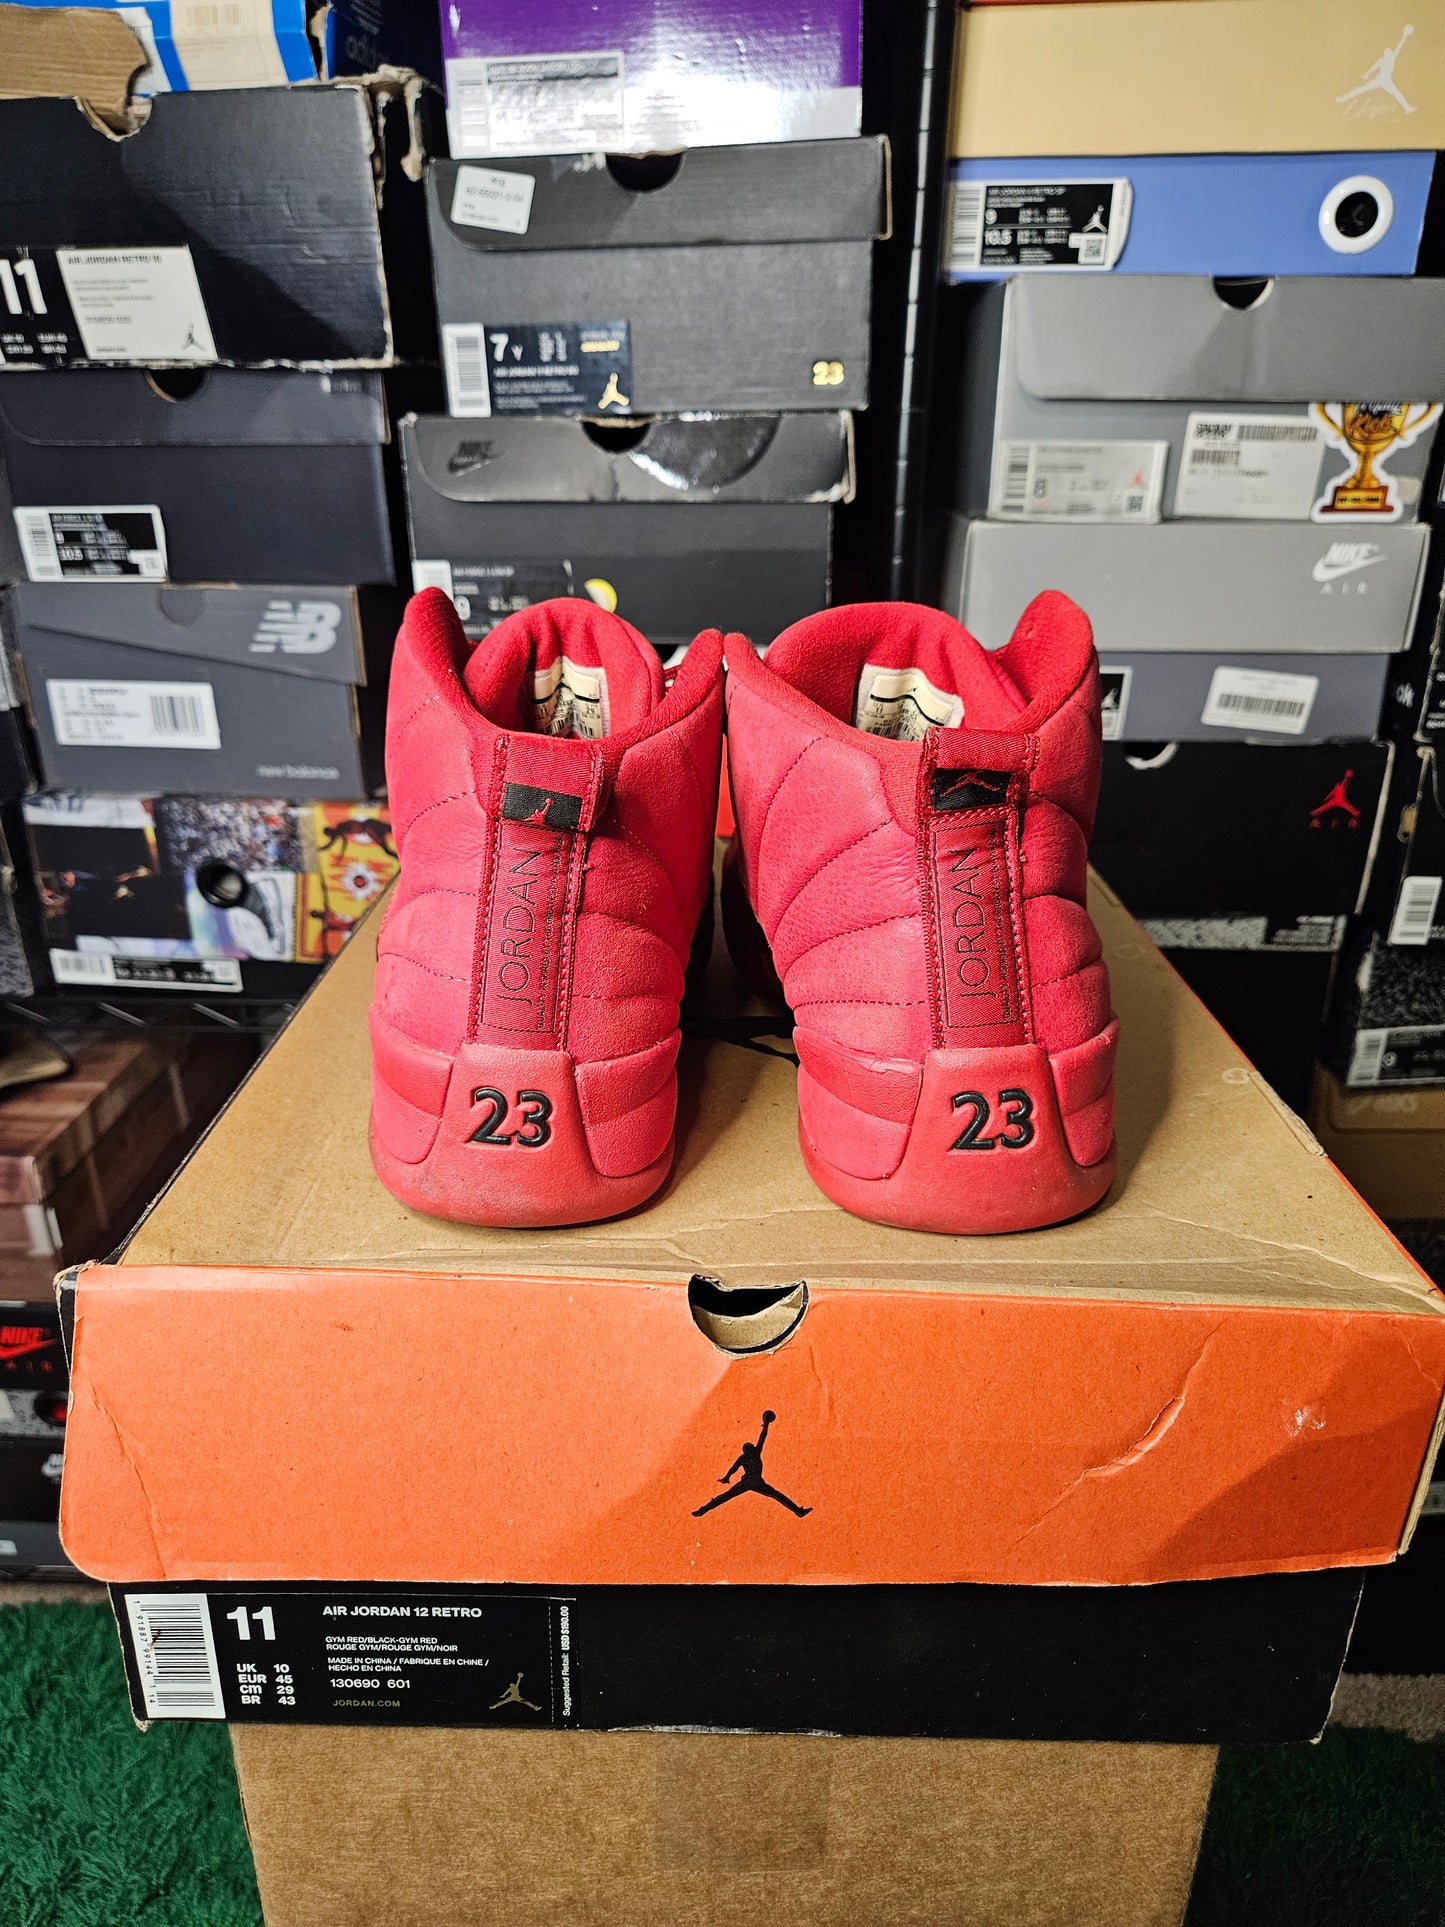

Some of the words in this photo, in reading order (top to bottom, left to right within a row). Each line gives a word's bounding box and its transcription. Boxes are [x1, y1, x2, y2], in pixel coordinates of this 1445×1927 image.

[0, 259, 48, 314] 11
[489, 333, 509, 362] 7
[813, 361, 845, 386] 23
[1324, 542, 1371, 564] NIKE
[1320, 582, 1368, 595] AIR
[497, 848, 542, 1005] JORDAN
[950, 848, 996, 998] JORDAN
[471, 1087, 552, 1148] 23
[951, 1089, 1034, 1150] 23
[0, 1326, 43, 1345] NIKE
[323, 1606, 347, 1617] AIR
[350, 1606, 411, 1618] JORDAN
[413, 1607, 429, 1618] 12
[432, 1607, 483, 1618] RETRO
[560, 1605, 570, 1635] $190.00
[226, 1606, 276, 1641] 11
[325, 1636, 345, 1644] GYM
[347, 1636, 418, 1645] RED/BLACK-GYM
[326, 1643, 357, 1651] ROUGE
[358, 1644, 412, 1652] GYM/ROUGE
[560, 1634, 570, 1651] USD
[144, 1649, 154, 1675] 99144
[236, 1663, 257, 1673] UK
[273, 1663, 290, 1673] 10
[399, 1658, 441, 1666] FABRIQUE
[561, 1652, 570, 1676] Retail:
[238, 1674, 267, 1684] EUR
[275, 1675, 293, 1684] 45
[330, 1678, 380, 1689] 130690
[387, 1679, 411, 1689] 601
[241, 1695, 261, 1705] BR
[278, 1696, 296, 1706] 43
[276, 1686, 294, 1695] 29
[562, 1677, 572, 1717] Suggested
[332, 1700, 401, 1708] JORDAN.COM
